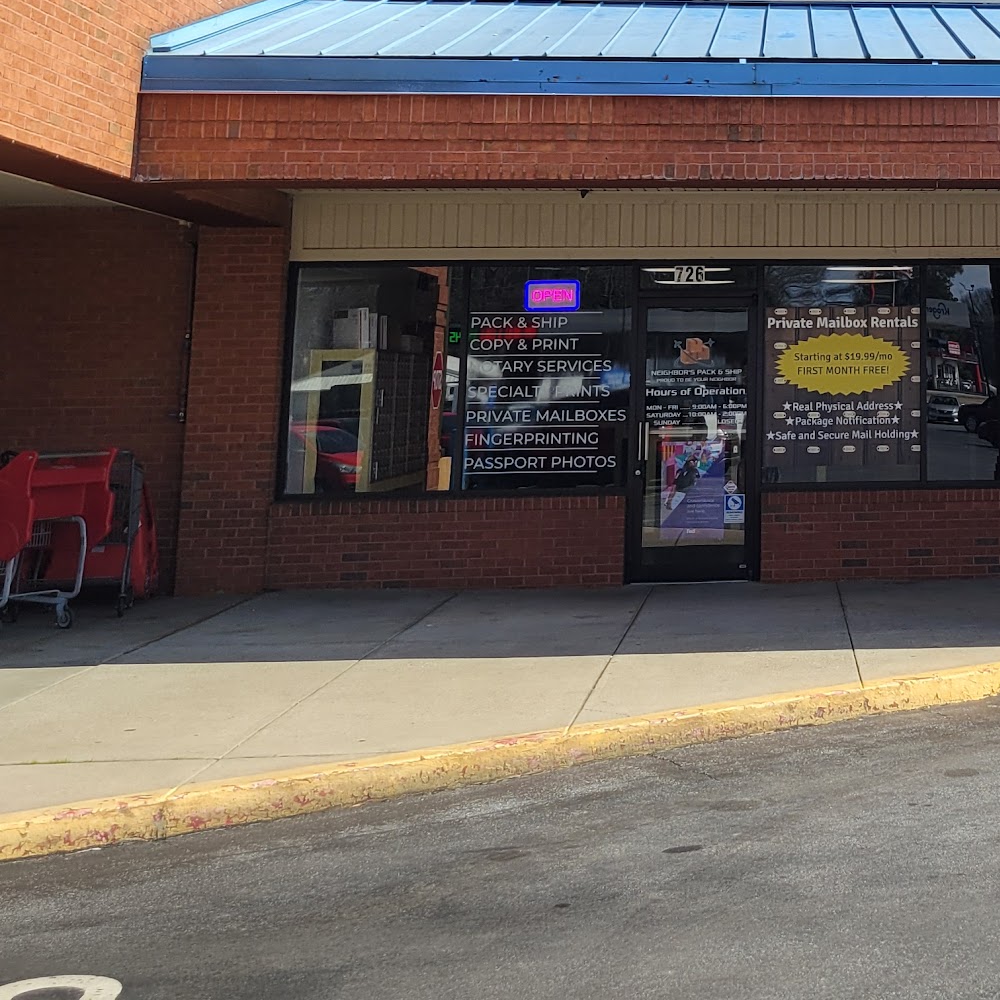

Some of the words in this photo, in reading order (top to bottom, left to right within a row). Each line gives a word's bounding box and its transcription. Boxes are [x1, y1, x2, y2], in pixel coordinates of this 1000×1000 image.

[675, 267, 704, 282] 726
[531, 288, 573, 302] OPEN
[471, 316, 513, 329] PACK
[517, 316, 528, 329] &
[531, 316, 568, 329] SHIP
[767, 317, 813, 329] Private
[817, 316, 868, 329] Mailbox
[871, 316, 919, 328] Rentals
[469, 338, 514, 351] COPY
[517, 338, 528, 351] &
[532, 338, 579, 350] PRINT
[794, 352, 831, 362] Starting
[844, 351, 893, 361] $19.99/mo
[537, 360, 612, 373] SERVICES
[797, 366, 824, 375] FIRST
[826, 366, 860, 375] MONTH
[863, 366, 889, 374] FREE!
[468, 385, 550, 398] SPECIALT
[646, 388, 677, 397] Hours
[680, 388, 691, 396] of
[694, 387, 746, 398] Operation
[792, 402, 813, 411] Real
[816, 401, 854, 413] Physical
[856, 401, 894, 411] Address
[466, 410, 531, 423] PRIVATE
[536, 409, 627, 422] MAILBOXES
[795, 416, 834, 427] Package
[835, 416, 892, 426] Notification
[464, 432, 599, 446] FINGERPRINTING
[775, 431, 796, 440] Safe
[798, 430, 815, 440] and
[817, 431, 849, 440] Secure
[852, 429, 872, 439] Mail
[874, 429, 911, 441] Holding
[464, 456, 547, 470] PASSPORT
[552, 456, 617, 469] PHOTOS
